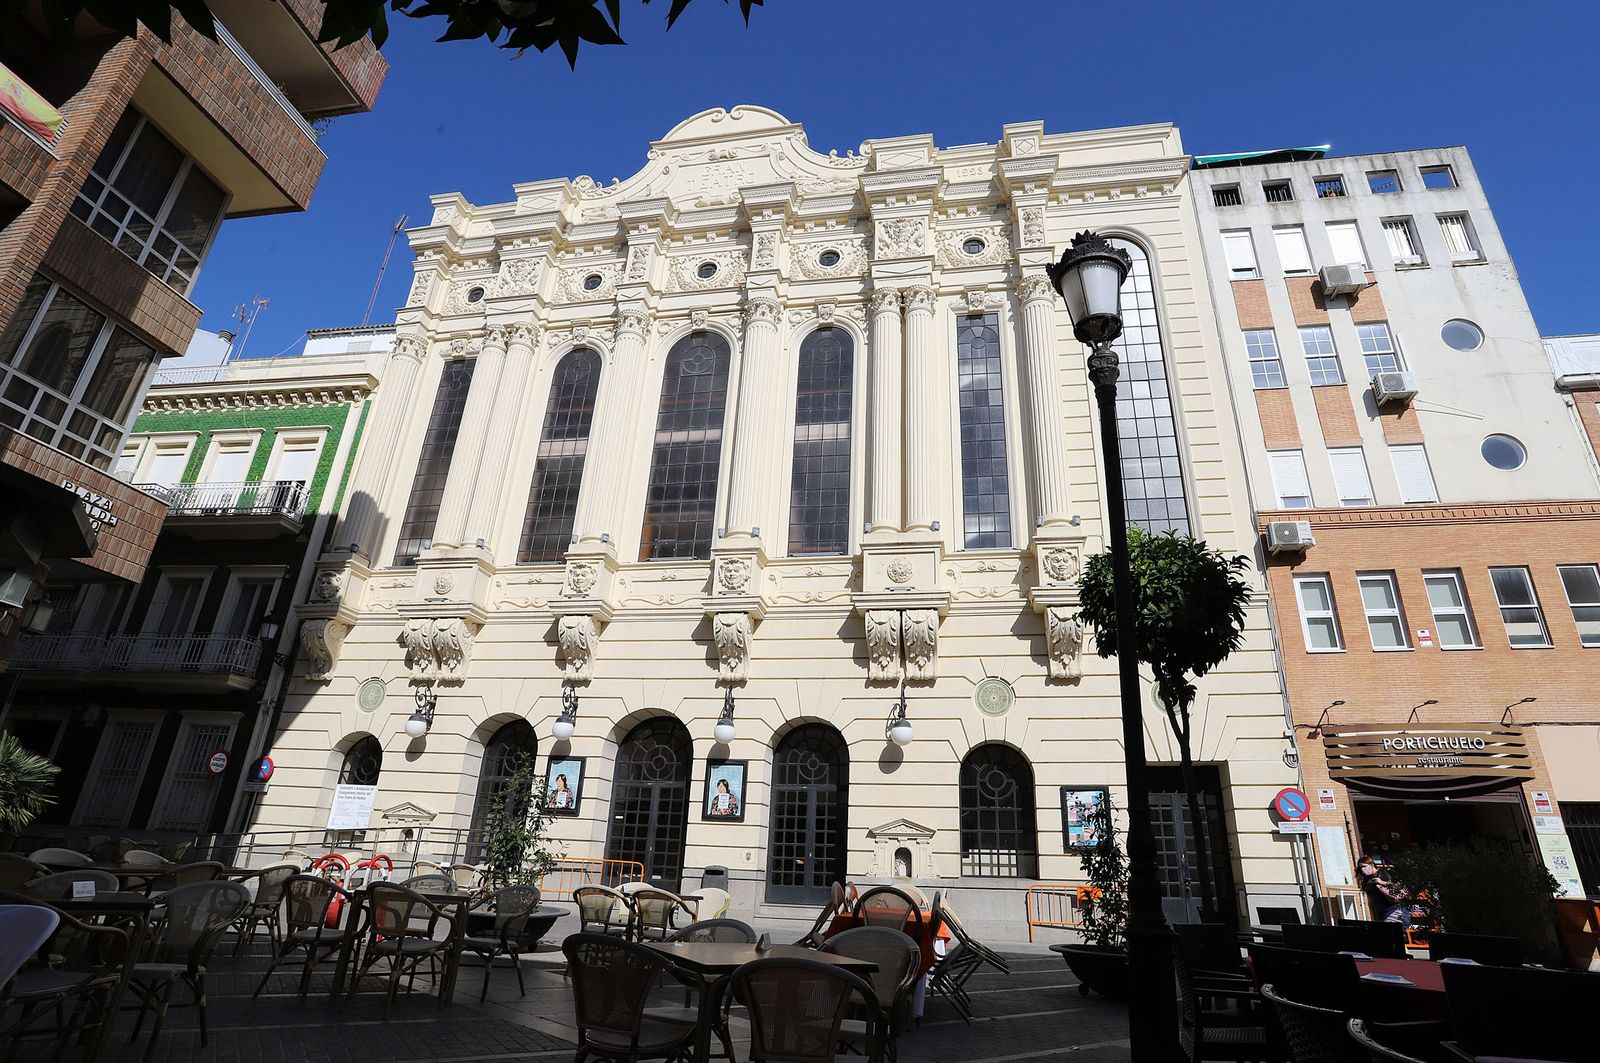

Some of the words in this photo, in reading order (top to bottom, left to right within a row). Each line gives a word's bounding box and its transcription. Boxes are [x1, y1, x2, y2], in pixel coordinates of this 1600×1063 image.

[64, 481, 111, 510] PLAZA
[1383, 736, 1485, 750] PORTICHUELO
[1418, 756, 1464, 764] restaurante
